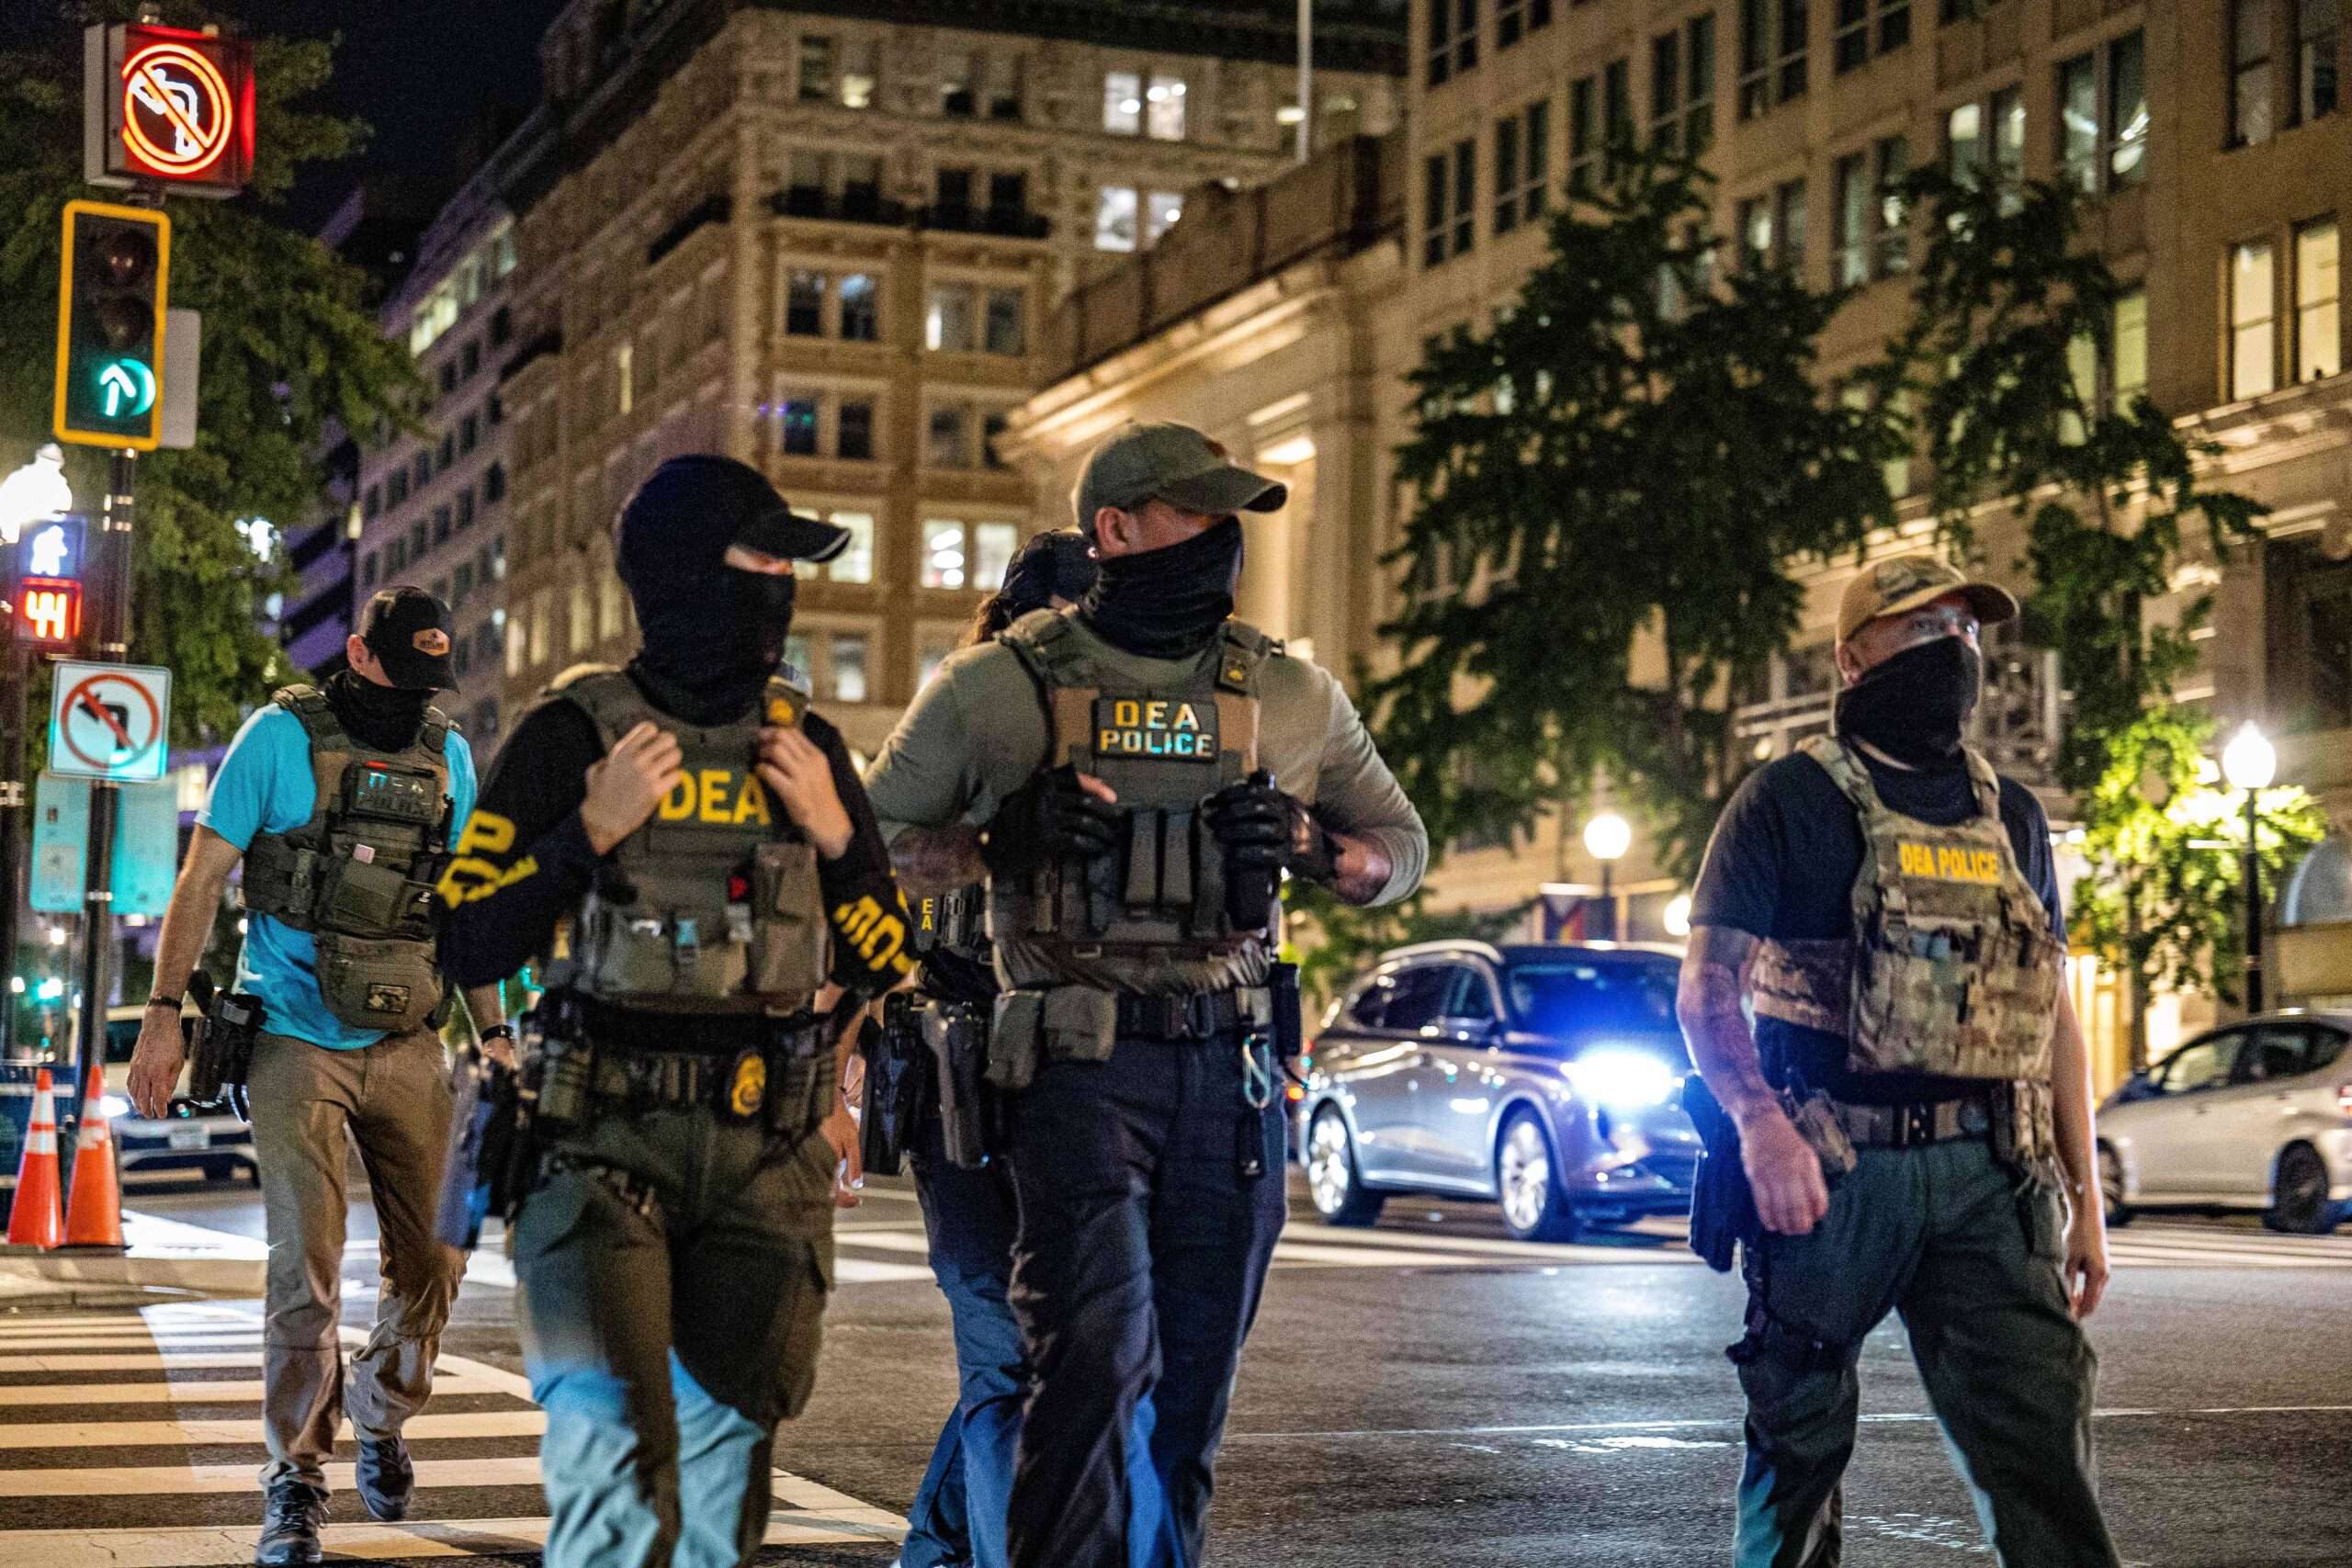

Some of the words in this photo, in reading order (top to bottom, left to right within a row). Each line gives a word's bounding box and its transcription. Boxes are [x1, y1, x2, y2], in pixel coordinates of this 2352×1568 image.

[1114, 700, 1200, 730] DEA
[1100, 728, 1214, 758] POLICE
[659, 769, 771, 824] DEA
[1899, 842, 1936, 877] DEA
[1938, 846, 2000, 883] POLICE
